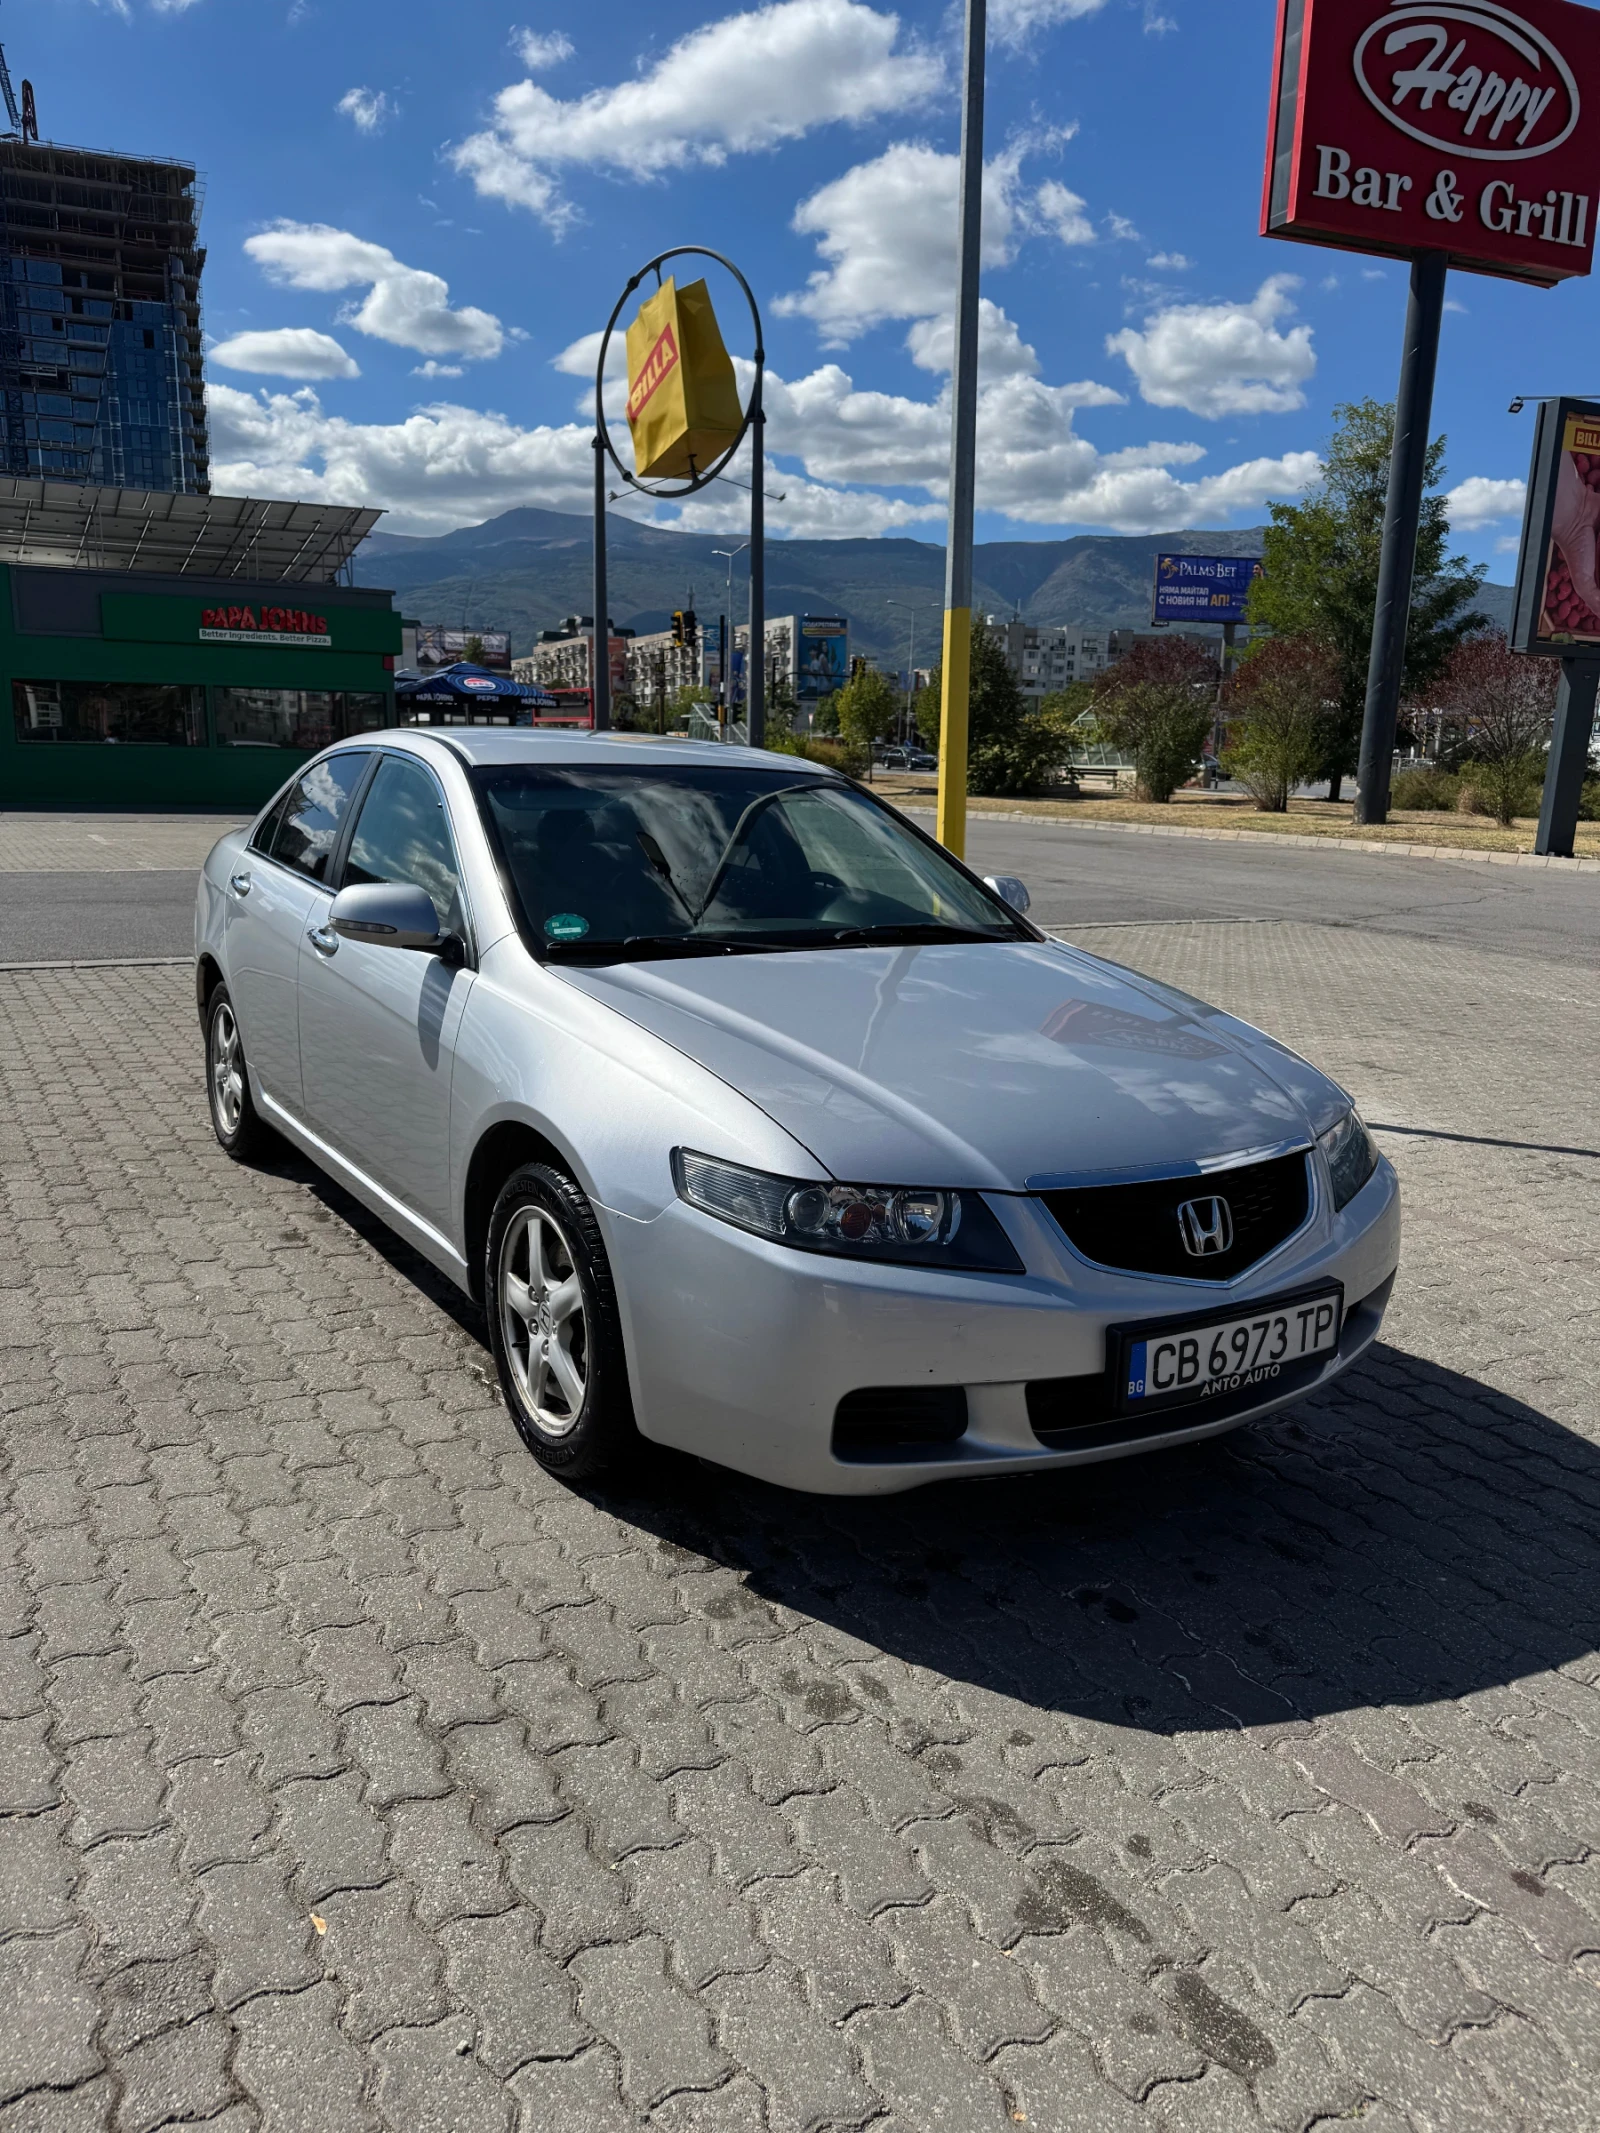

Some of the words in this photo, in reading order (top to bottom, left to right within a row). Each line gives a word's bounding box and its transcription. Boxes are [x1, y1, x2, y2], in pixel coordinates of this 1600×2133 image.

[1384, 24, 1556, 145] Happy
[1312, 145, 1413, 212] Bar
[1425, 169, 1465, 223] &
[1479, 180, 1590, 248] Grill
[630, 338, 675, 414] BILLA
[1575, 431, 1600, 448] BILL
[1158, 595, 1165, 605] С
[1166, 596, 1195, 606] НОВИЯ
[1196, 596, 1208, 606] НИ
[1210, 594, 1230, 607] АП!
[1159, 585, 1179, 594] НЯМА
[1180, 586, 1209, 595] МАЙТАП
[202, 606, 257, 629] PAPA
[258, 606, 327, 634] JOHNS
[201, 630, 227, 639] Better
[228, 631, 278, 641] Ingredients.
[280, 634, 305, 643] Better
[306, 636, 330, 644] Pizza.
[476, 695, 500, 703] PEPSI
[1152, 1338, 1200, 1389] CB
[1208, 1317, 1288, 1376] 6973
[1297, 1303, 1334, 1352] TP
[1128, 1379, 1144, 1395] BG
[1200, 1373, 1241, 1397] ANTO
[1243, 1363, 1281, 1385] AUTO
